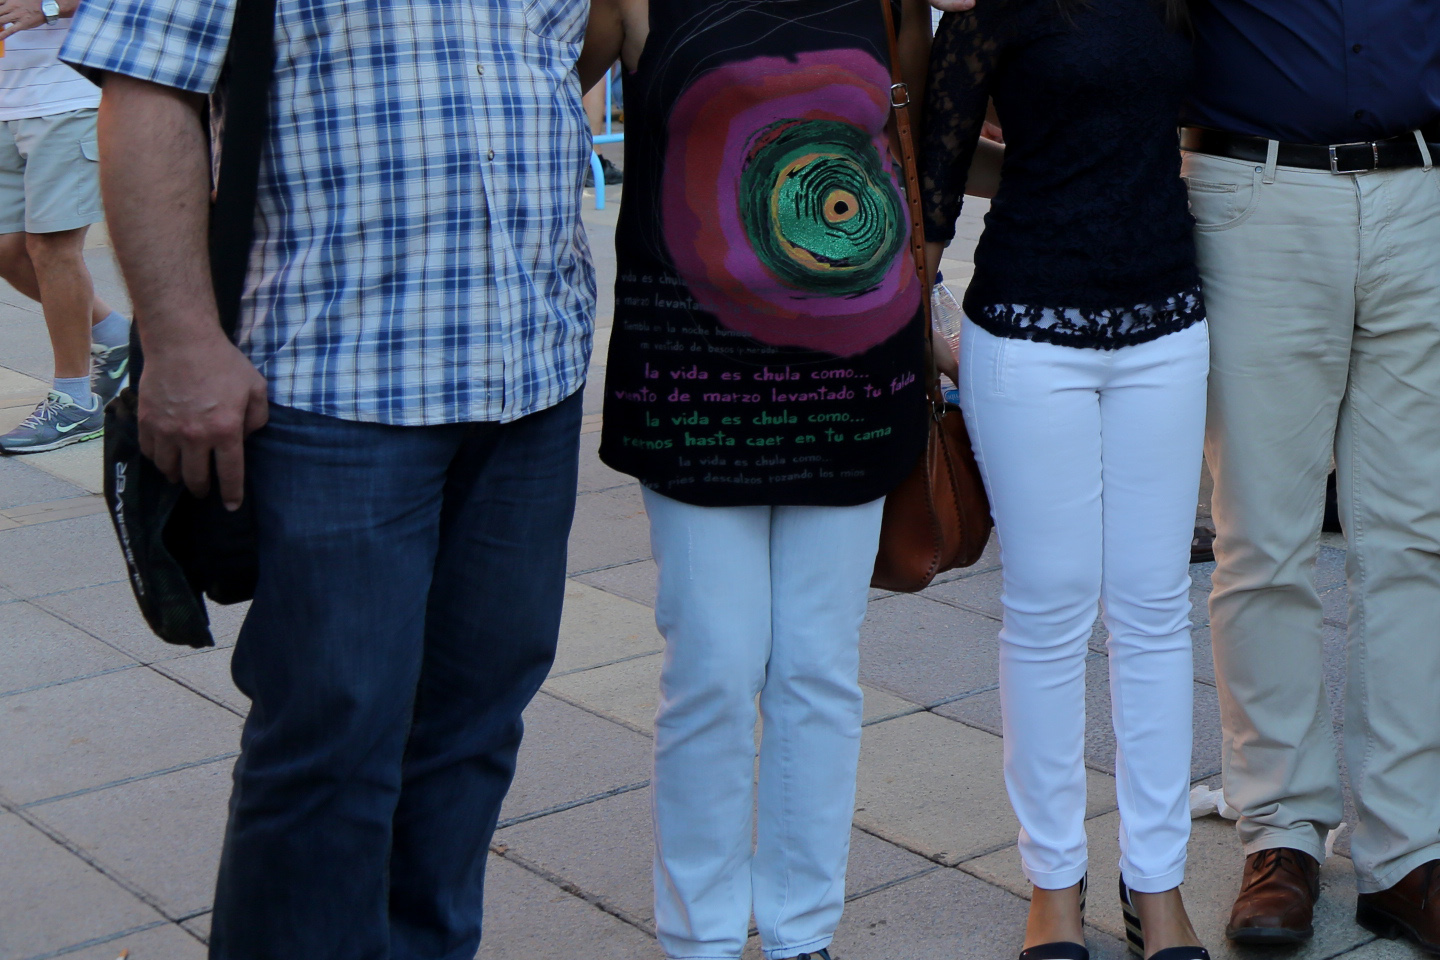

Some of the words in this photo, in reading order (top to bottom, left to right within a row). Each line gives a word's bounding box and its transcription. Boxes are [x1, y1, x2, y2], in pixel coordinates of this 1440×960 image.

[644, 361, 660, 380] la
[670, 364, 709, 380] vida
[720, 371, 742, 381] es
[753, 366, 801, 382] chula
[810, 367, 870, 380] como...
[667, 387, 692, 403] de
[702, 392, 762, 404] marzo
[771, 386, 856, 403] levantado
[863, 384, 883, 400] tu
[889, 372, 916, 396] falda
[645, 410, 660, 427] la
[670, 410, 710, 426] vida
[720, 415, 742, 426] es
[752, 409, 798, 426] chula
[807, 411, 865, 424] como...
[684, 430, 736, 447] hasta
[746, 434, 784, 447] caer
[795, 434, 817, 446] en
[824, 427, 845, 444] tu
[853, 426, 893, 441] cama
[678, 455, 692, 467] la
[699, 454, 727, 466] vida
[734, 458, 749, 467] es
[755, 454, 787, 467] chula
[703, 471, 763, 485] descalzos
[768, 468, 814, 483] rozando
[819, 467, 835, 478] los
